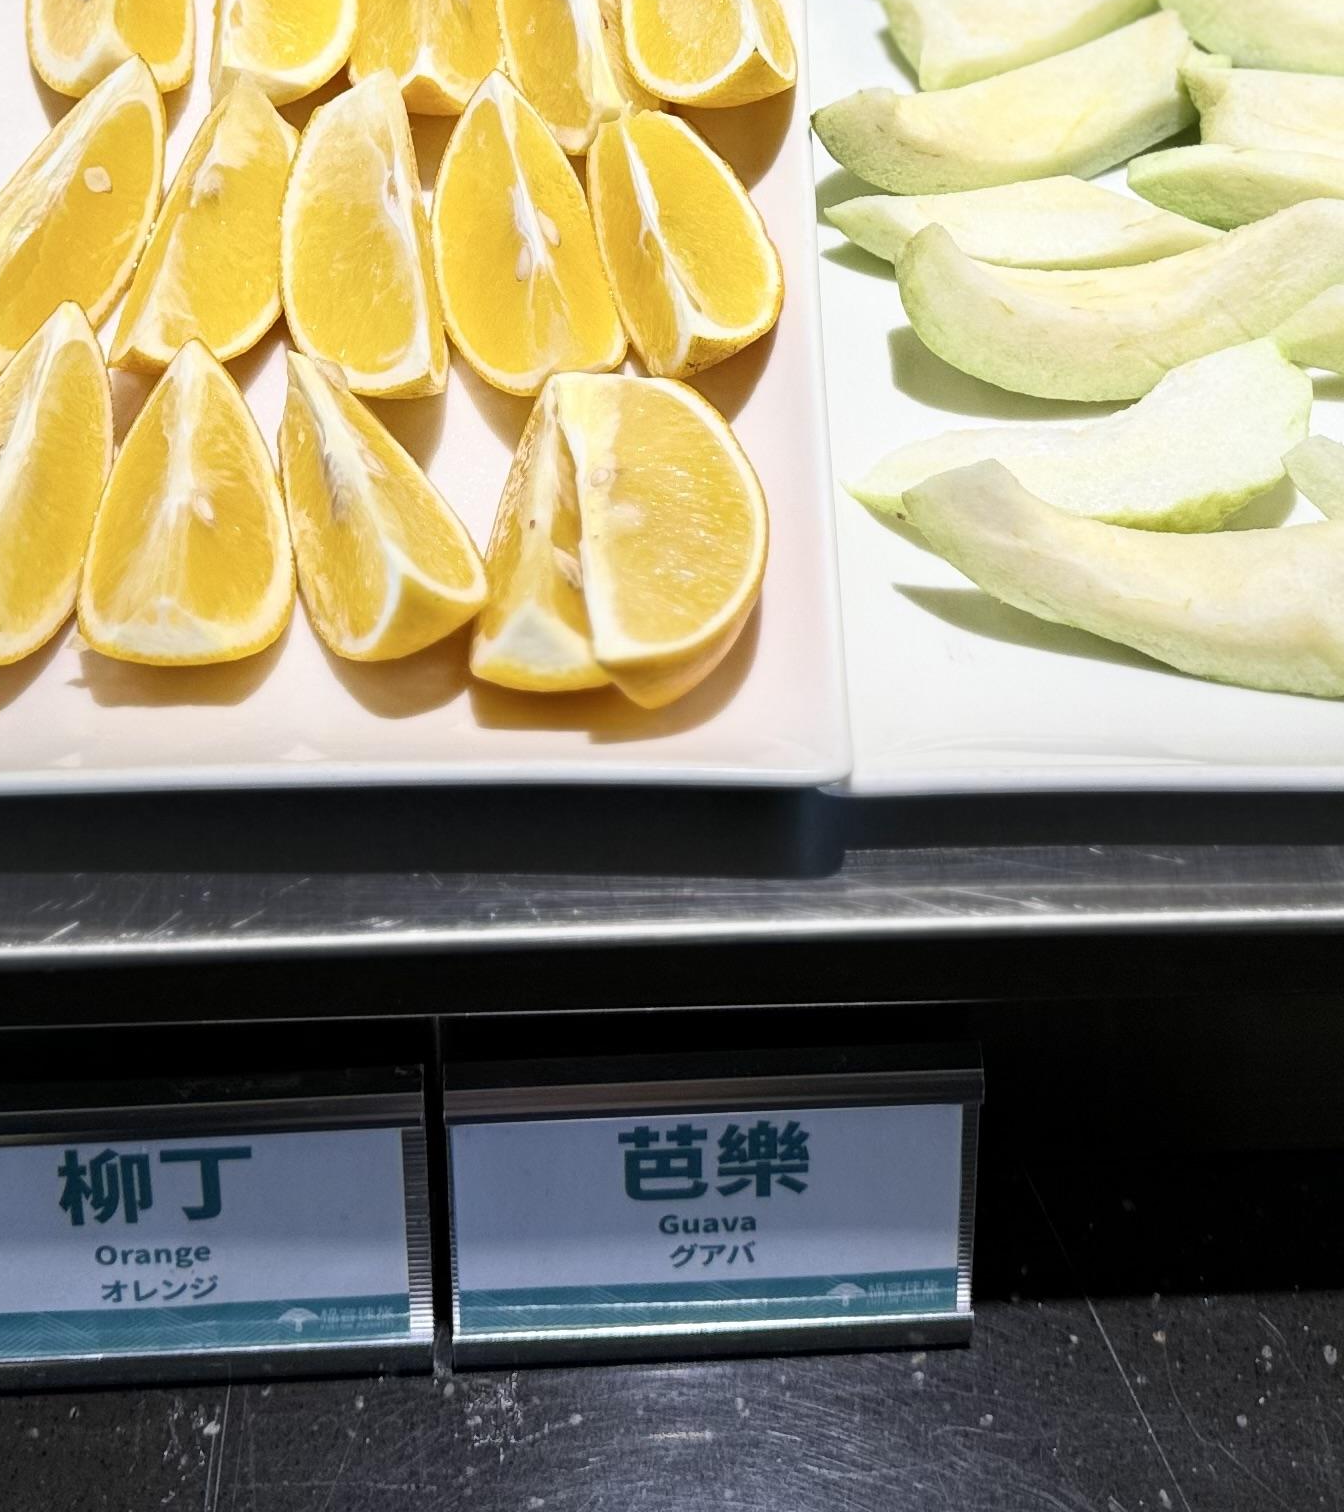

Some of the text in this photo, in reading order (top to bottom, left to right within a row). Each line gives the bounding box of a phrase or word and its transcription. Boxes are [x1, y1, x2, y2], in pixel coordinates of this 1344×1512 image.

[617, 1120, 811, 1202] 芭樂
[57, 1145, 253, 1227] 柳丁
[658, 1213, 757, 1235] Guava
[94, 1243, 212, 1269] Orange
[669, 1241, 757, 1268] グアバ
[101, 1275, 219, 1303] オレンジ
